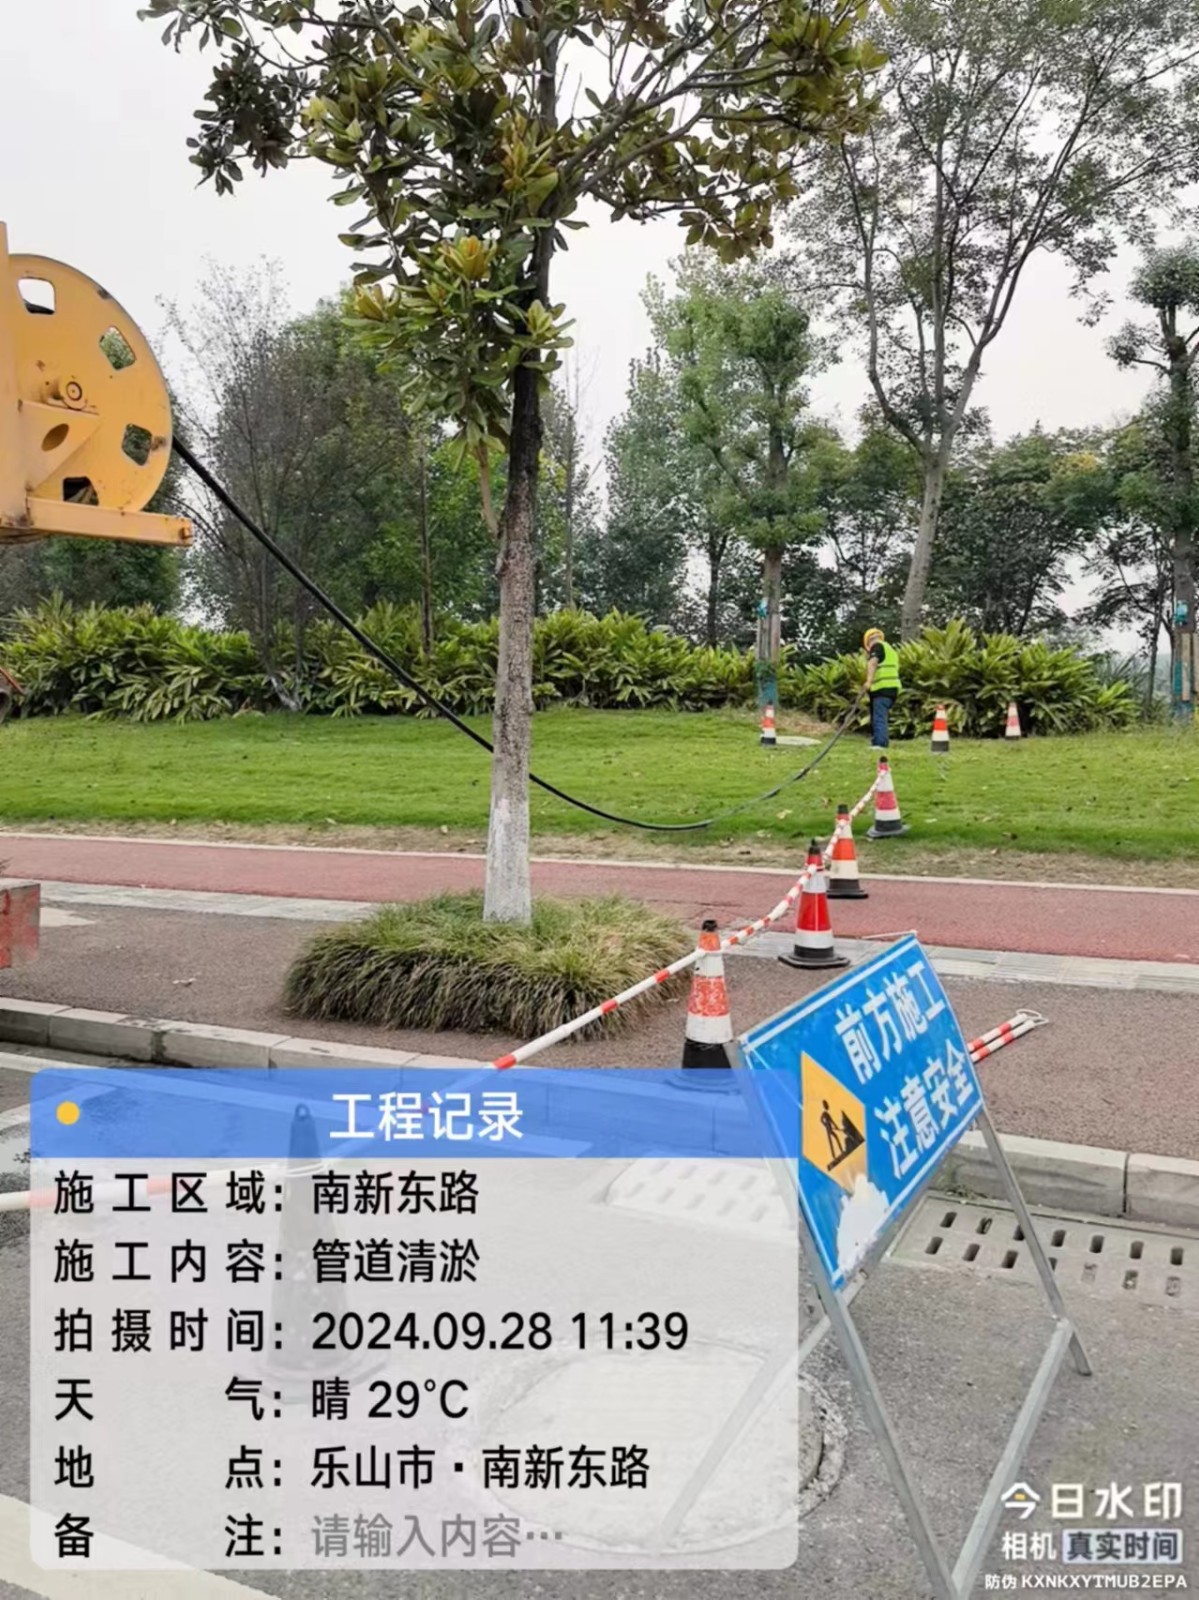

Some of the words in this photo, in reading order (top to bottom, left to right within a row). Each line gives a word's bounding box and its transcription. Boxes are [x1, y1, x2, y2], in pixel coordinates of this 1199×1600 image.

[835, 961, 947, 1085] 前方施工
[874, 1039, 975, 1180] 注意安全
